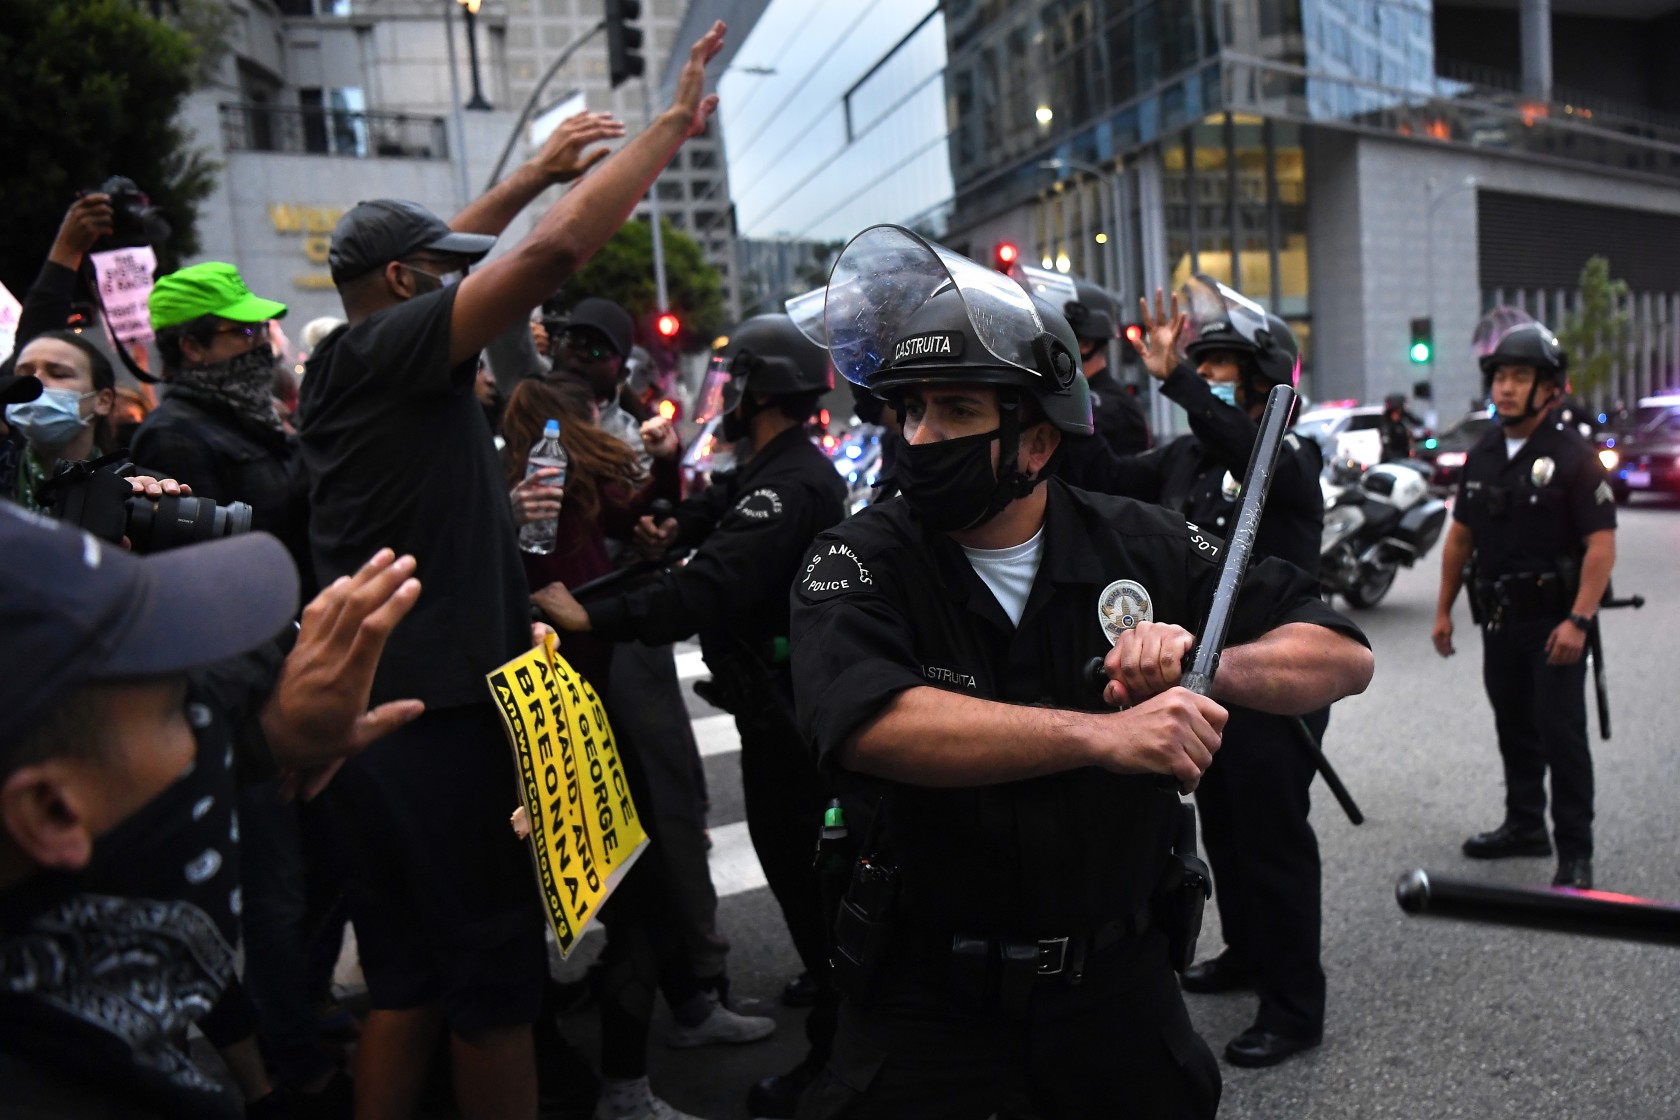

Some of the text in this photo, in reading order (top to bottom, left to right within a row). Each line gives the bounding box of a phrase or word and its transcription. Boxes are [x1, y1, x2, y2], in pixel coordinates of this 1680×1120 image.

[895, 336, 951, 361] CASTRUITA
[802, 554, 822, 583] LOS
[1190, 535, 1218, 556] LOS
[807, 579, 850, 592] POLICE
[921, 664, 977, 689] STRUITA
[553, 653, 618, 865] OR GEORGE,
[577, 672, 634, 826] USTICE
[496, 685, 568, 938] AnswerCoalition.org
[514, 665, 588, 921] BREONNA!
[572, 825, 600, 893] AND
